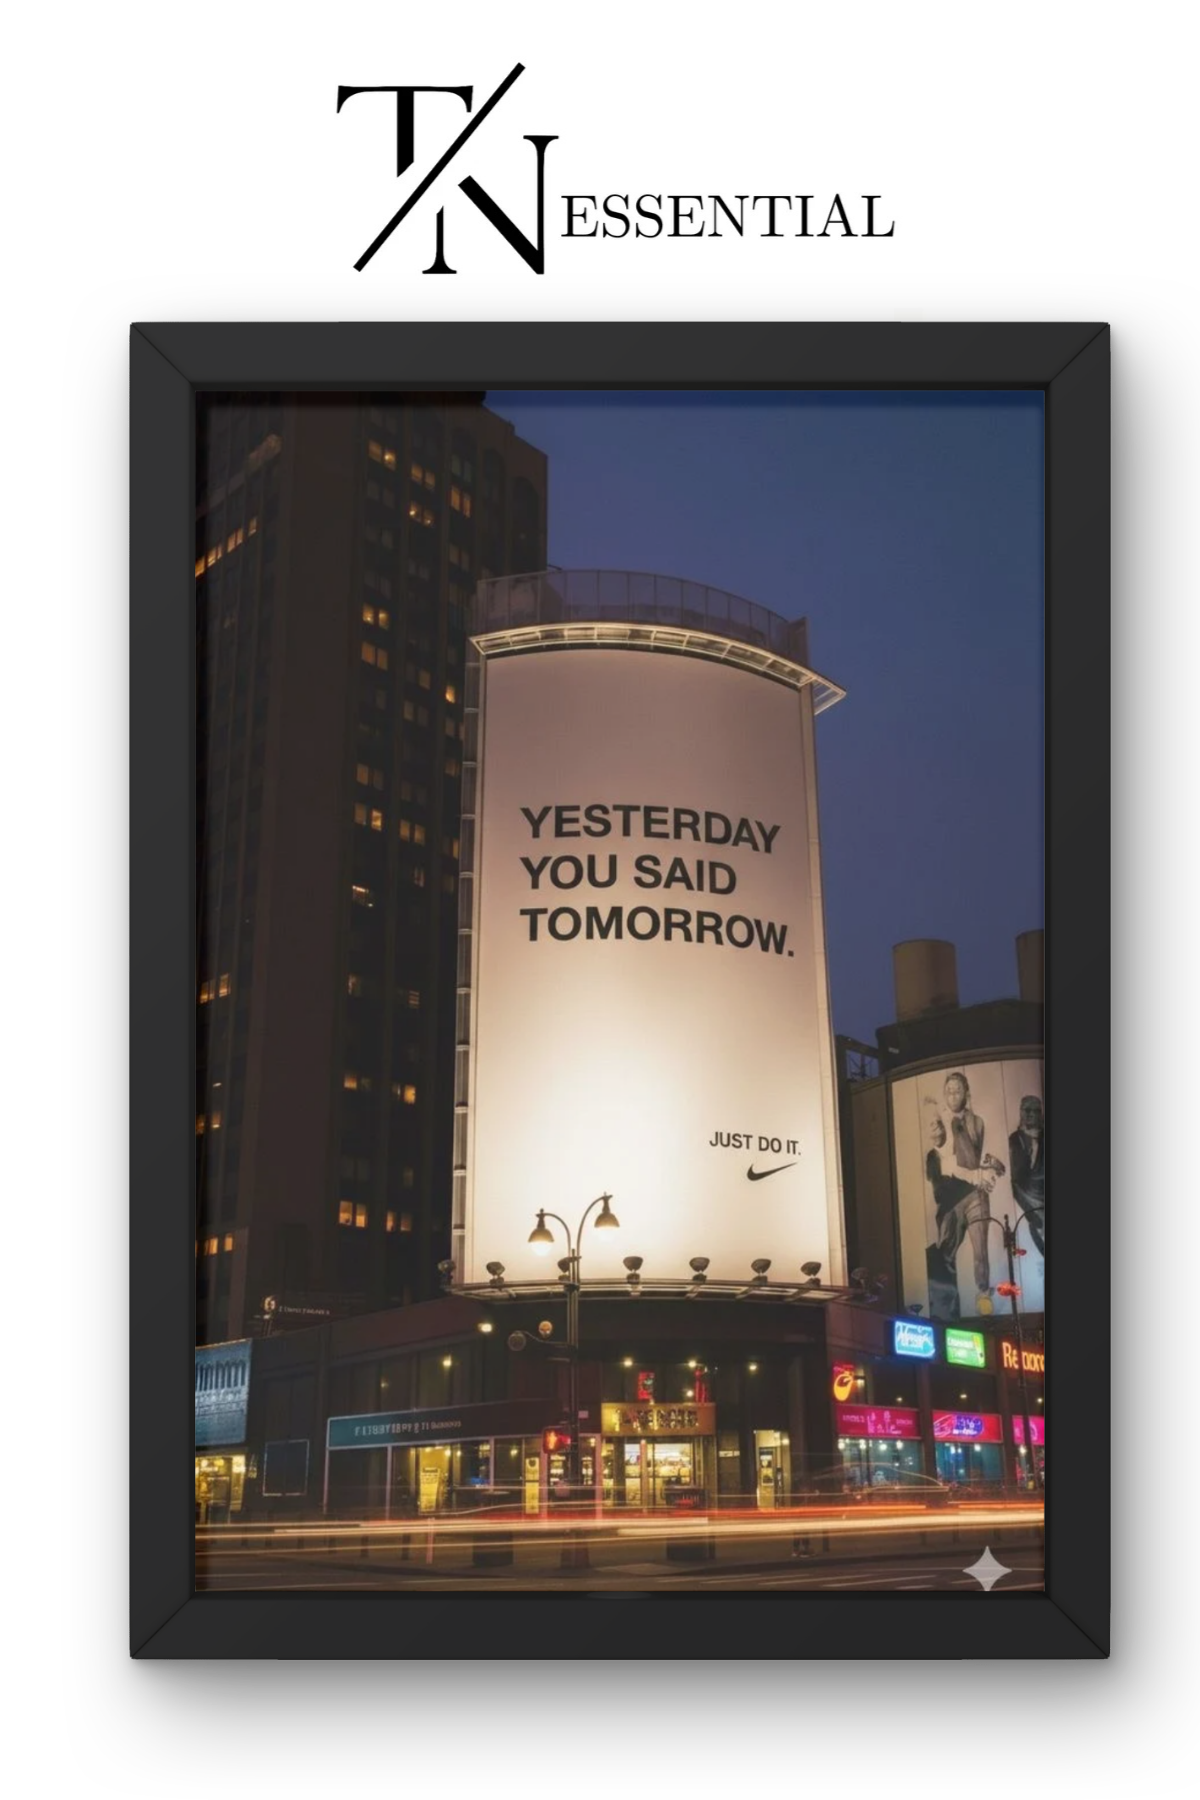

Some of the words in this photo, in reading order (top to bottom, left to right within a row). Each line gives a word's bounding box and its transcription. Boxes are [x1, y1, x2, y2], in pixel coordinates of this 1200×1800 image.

[519, 803, 781, 854] YESTERDAY
[519, 854, 618, 890] YOU
[633, 854, 737, 896] SAID
[519, 906, 795, 958] TOMORROW.
[709, 1131, 753, 1150] JUST
[758, 1136, 782, 1153] DO
[786, 1139, 801, 1156] IT.
